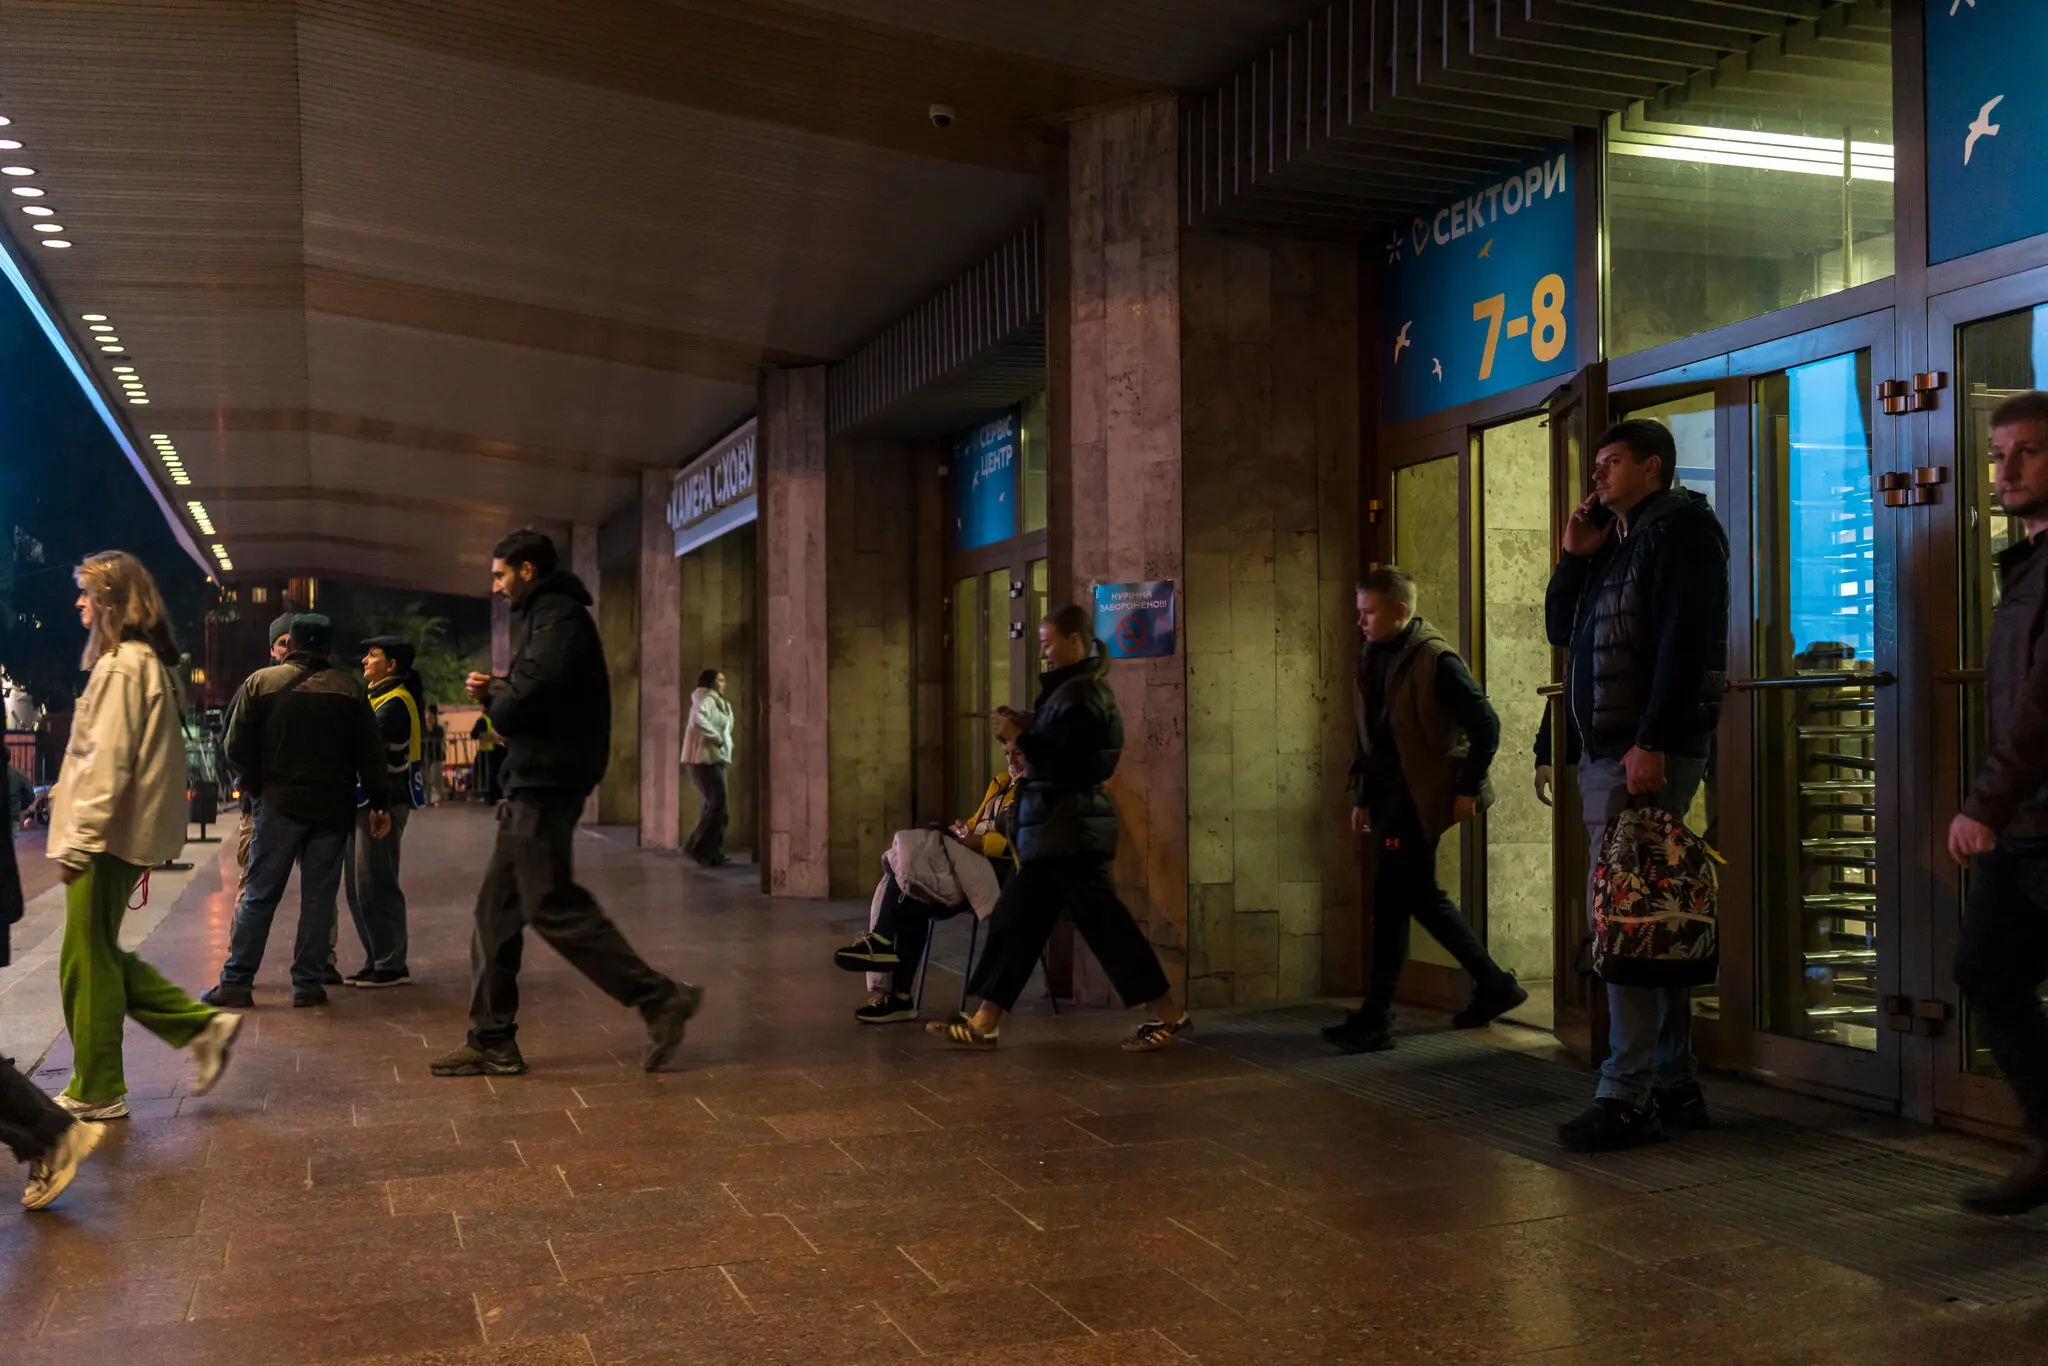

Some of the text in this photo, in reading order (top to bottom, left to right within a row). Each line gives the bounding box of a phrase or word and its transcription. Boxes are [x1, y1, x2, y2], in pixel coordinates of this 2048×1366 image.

[1433, 153, 1566, 246] СЕКТОРИ
[1473, 273, 1567, 381] 7-8
[980, 414, 1013, 448] СЕРВІС
[981, 444, 1013, 479] ЦЕНТР
[672, 434, 755, 531] КАМЕРА СХОВУ
[1111, 590, 1152, 601] КУРІННЯ
